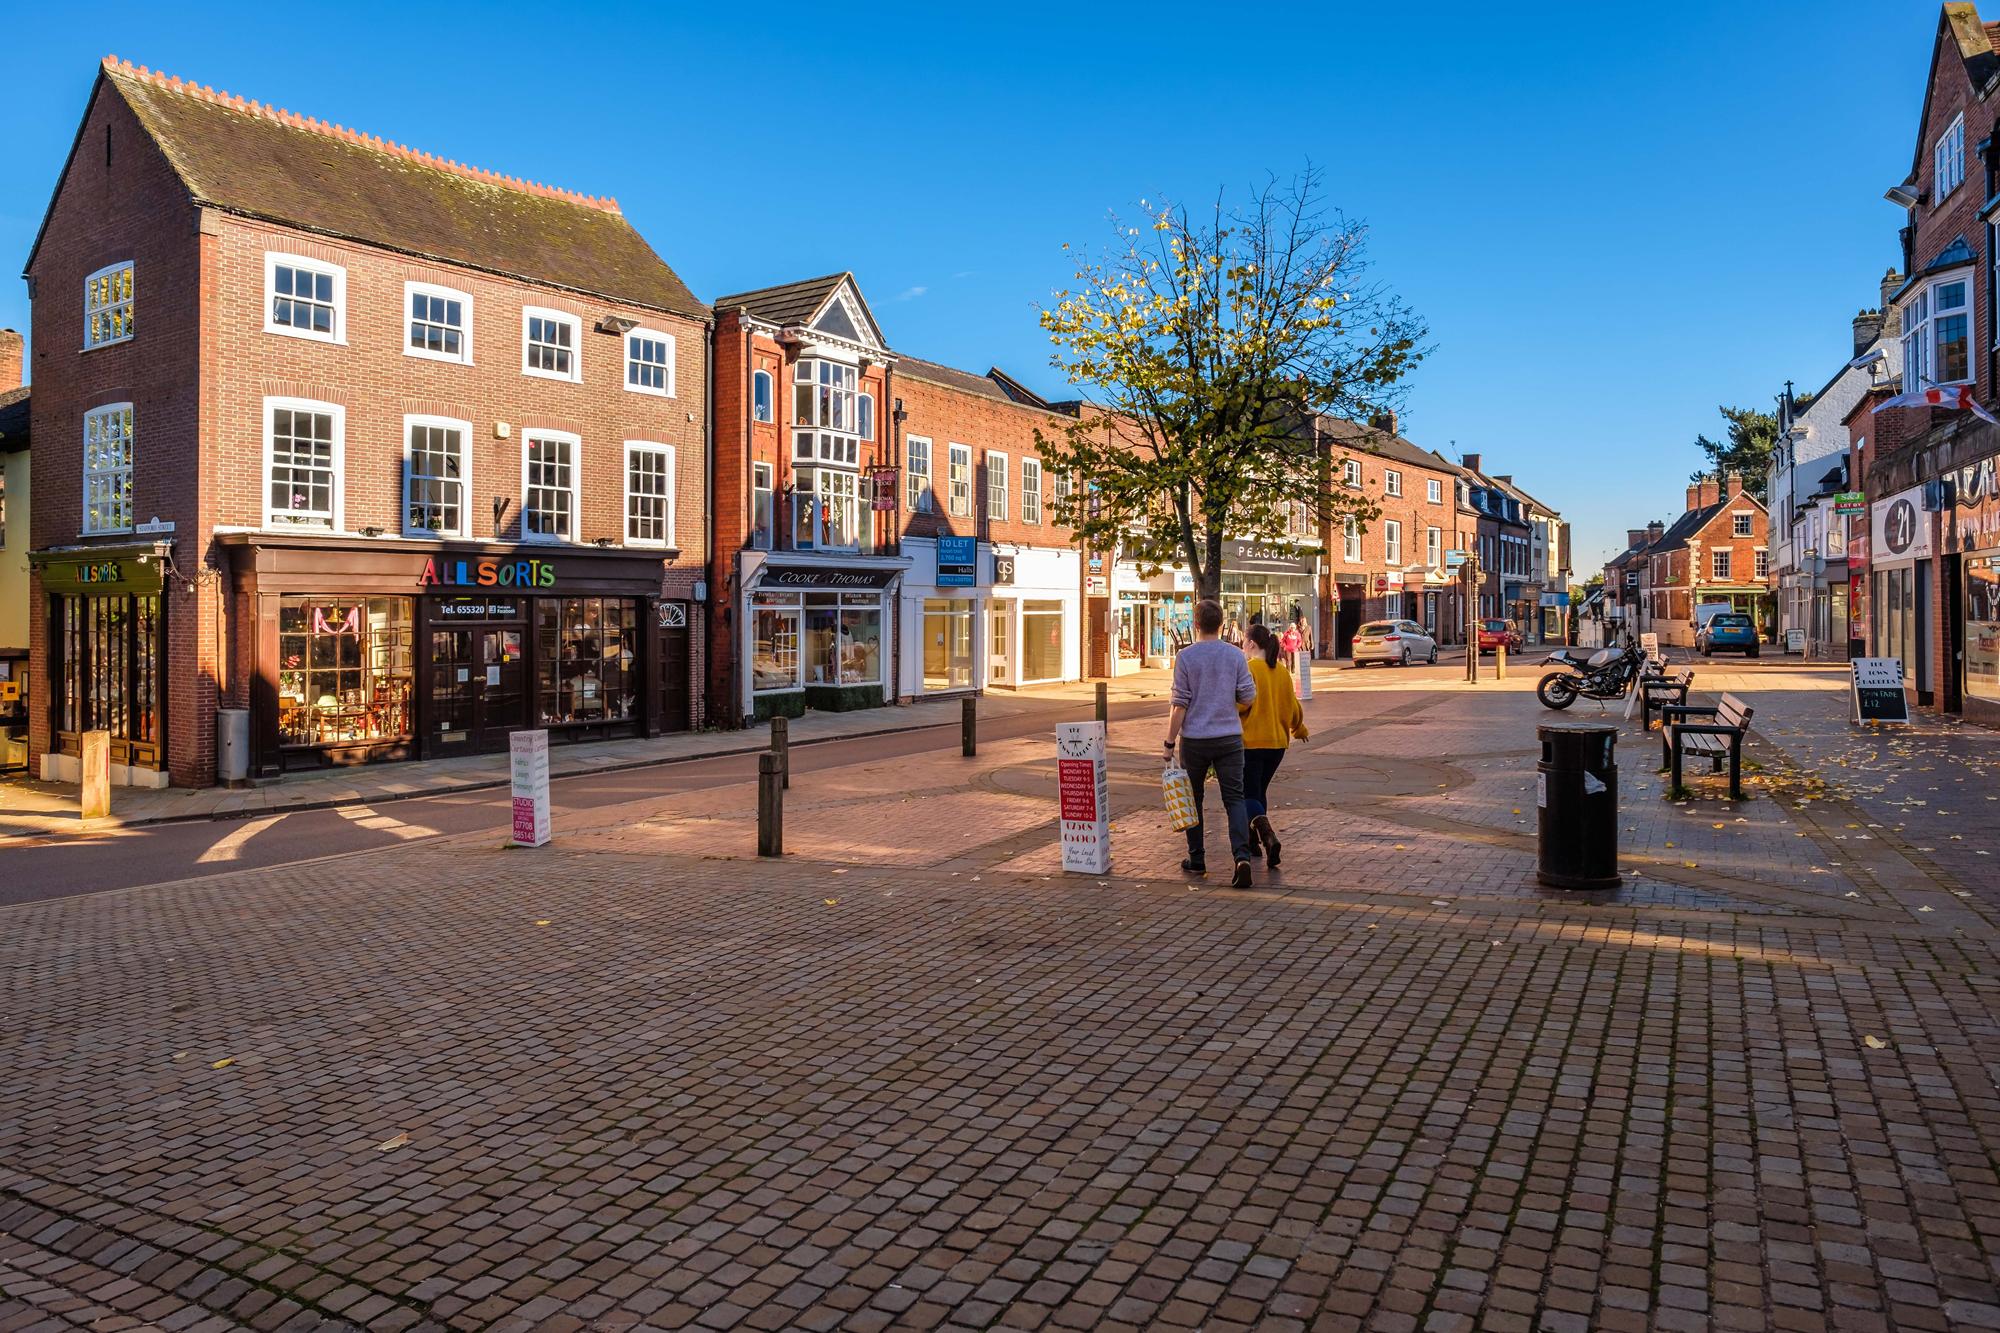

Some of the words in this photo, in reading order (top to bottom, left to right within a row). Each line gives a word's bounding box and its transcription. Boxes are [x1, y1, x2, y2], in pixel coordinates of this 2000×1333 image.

[1896, 504, 1911, 546] 21
[941, 539, 951, 548] TO
[953, 539, 969, 548] LET
[416, 558, 556, 588] ALLSORTS
[779, 572, 820, 584] COOKE
[830, 573, 876, 585] THOMAS
[441, 605, 455, 614] Tel.
[457, 605, 485, 614] 655320
[513, 797, 534, 807] STUDIO
[1081, 848, 1095, 856] Local
